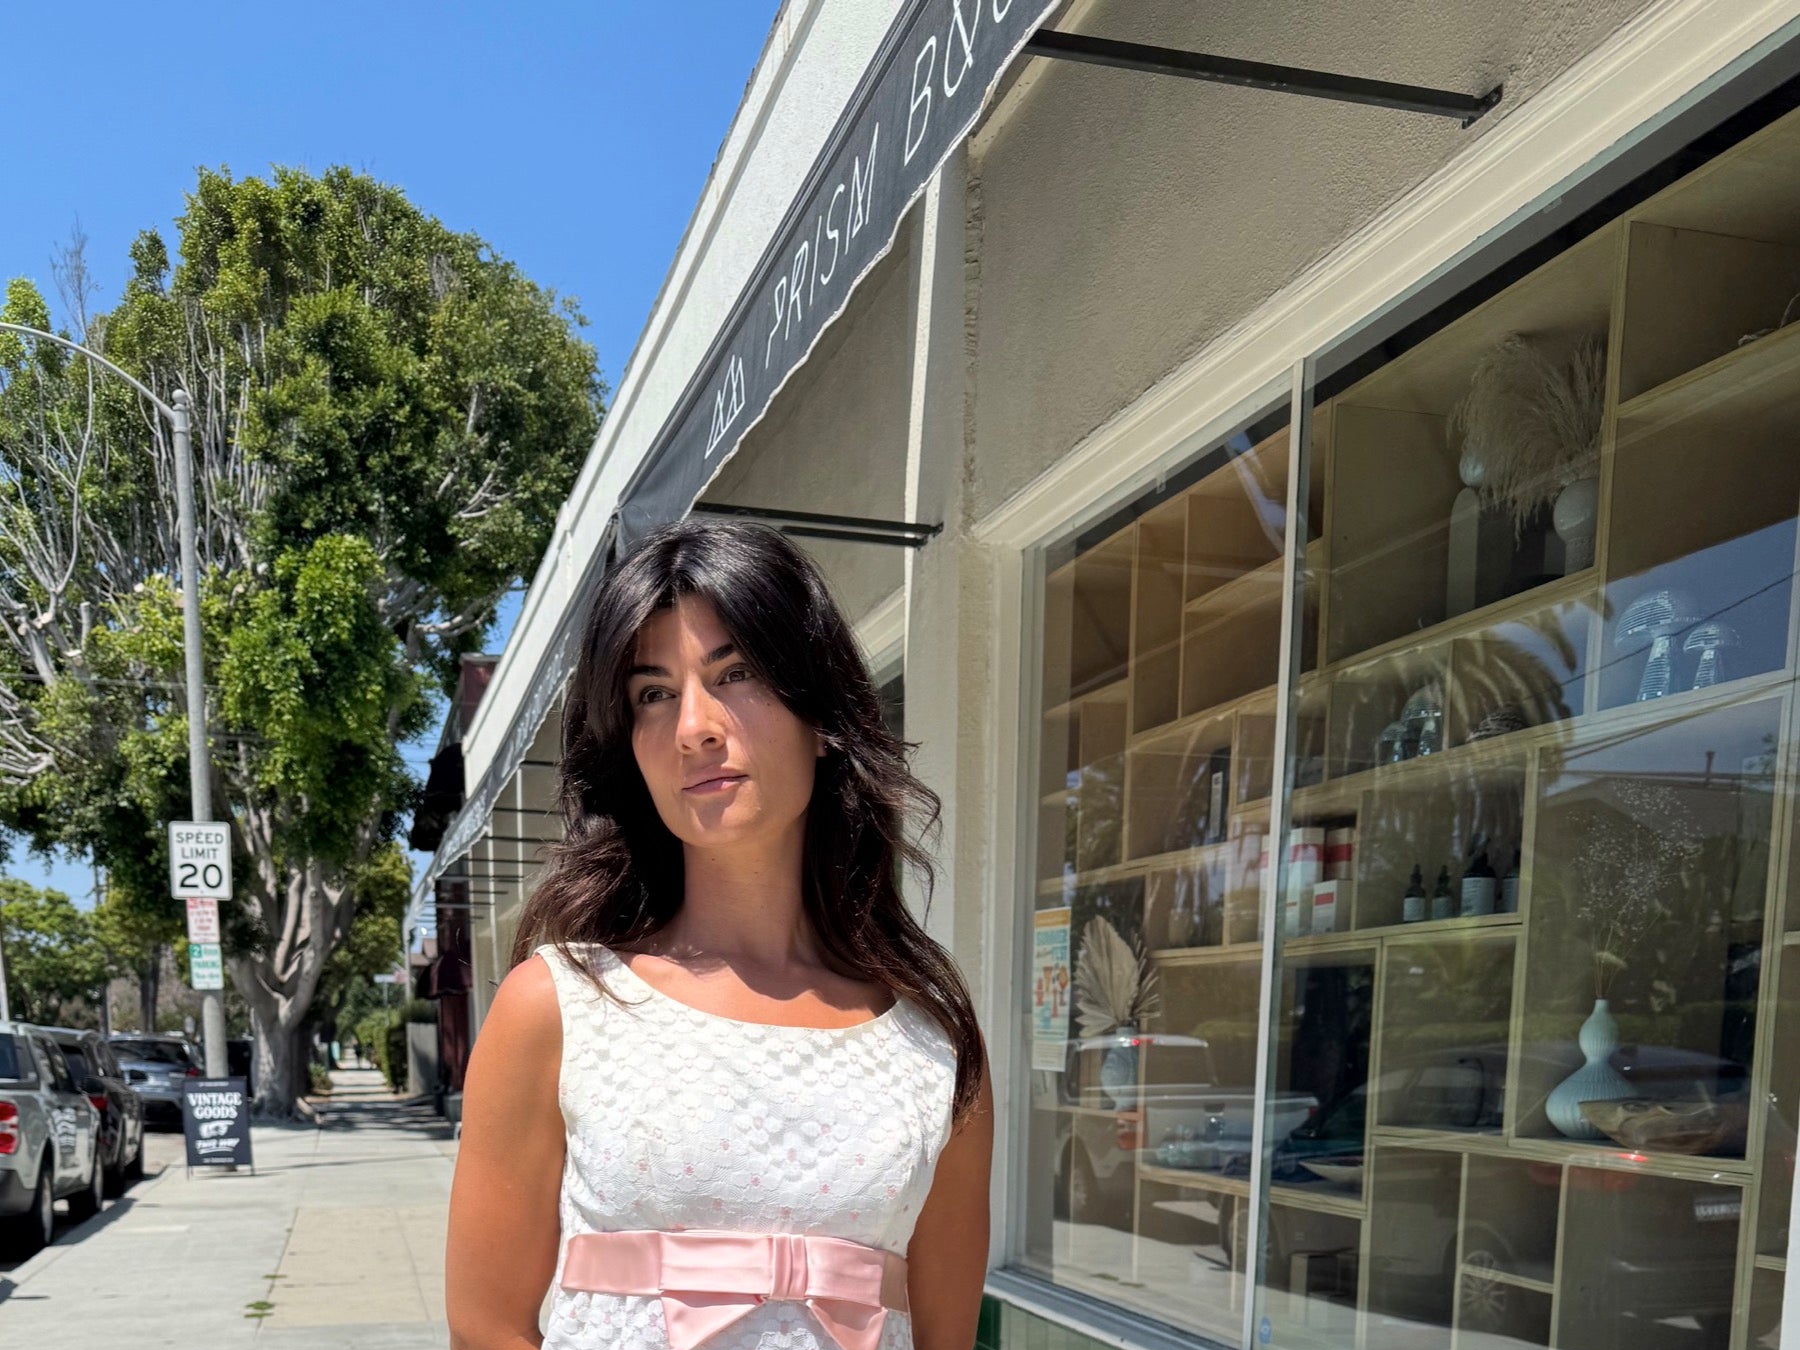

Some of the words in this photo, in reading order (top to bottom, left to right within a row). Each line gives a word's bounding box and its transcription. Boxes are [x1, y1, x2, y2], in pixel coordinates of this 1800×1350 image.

[765, 121, 880, 370] PRISM
[175, 832, 224, 845] SPEED
[181, 847, 219, 860] LIMIT
[179, 863, 223, 889] 20
[186, 1092, 242, 1106] VINTAGE
[193, 1105, 238, 1119] GOODS
